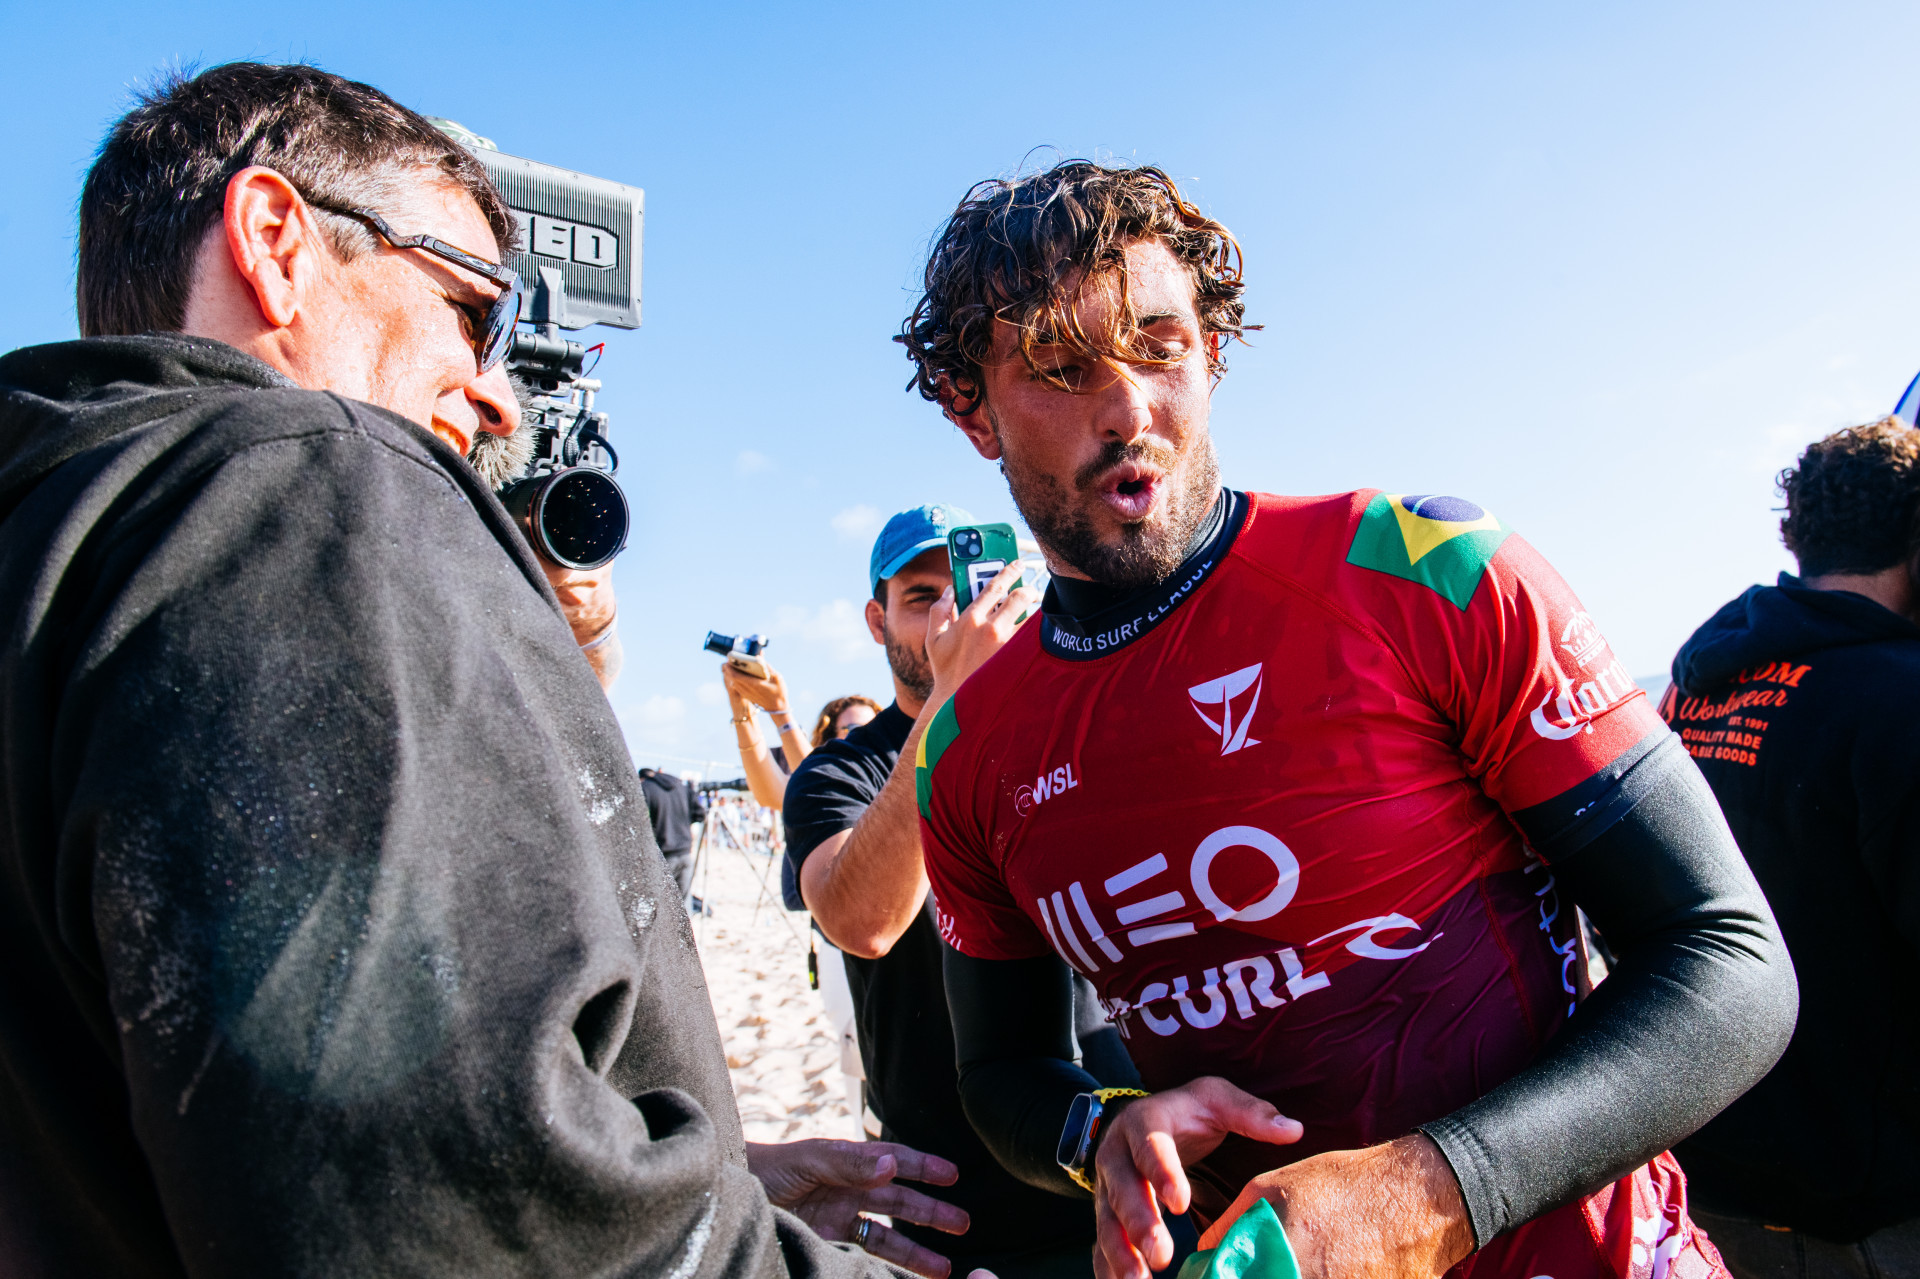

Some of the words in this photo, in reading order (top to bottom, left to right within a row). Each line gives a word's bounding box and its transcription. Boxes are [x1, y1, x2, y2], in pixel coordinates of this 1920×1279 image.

[1052, 626, 1093, 652] WORLD
[1096, 617, 1143, 650] SURF
[1682, 727, 1726, 743] QUALITY
[1726, 730, 1763, 750] MADE
[1744, 717, 1769, 732] 1991
[1715, 746, 1757, 767] GOODS
[1033, 763, 1078, 804] WSL
[1037, 825, 1300, 974] MEO
[1132, 947, 1331, 1037] CURL
